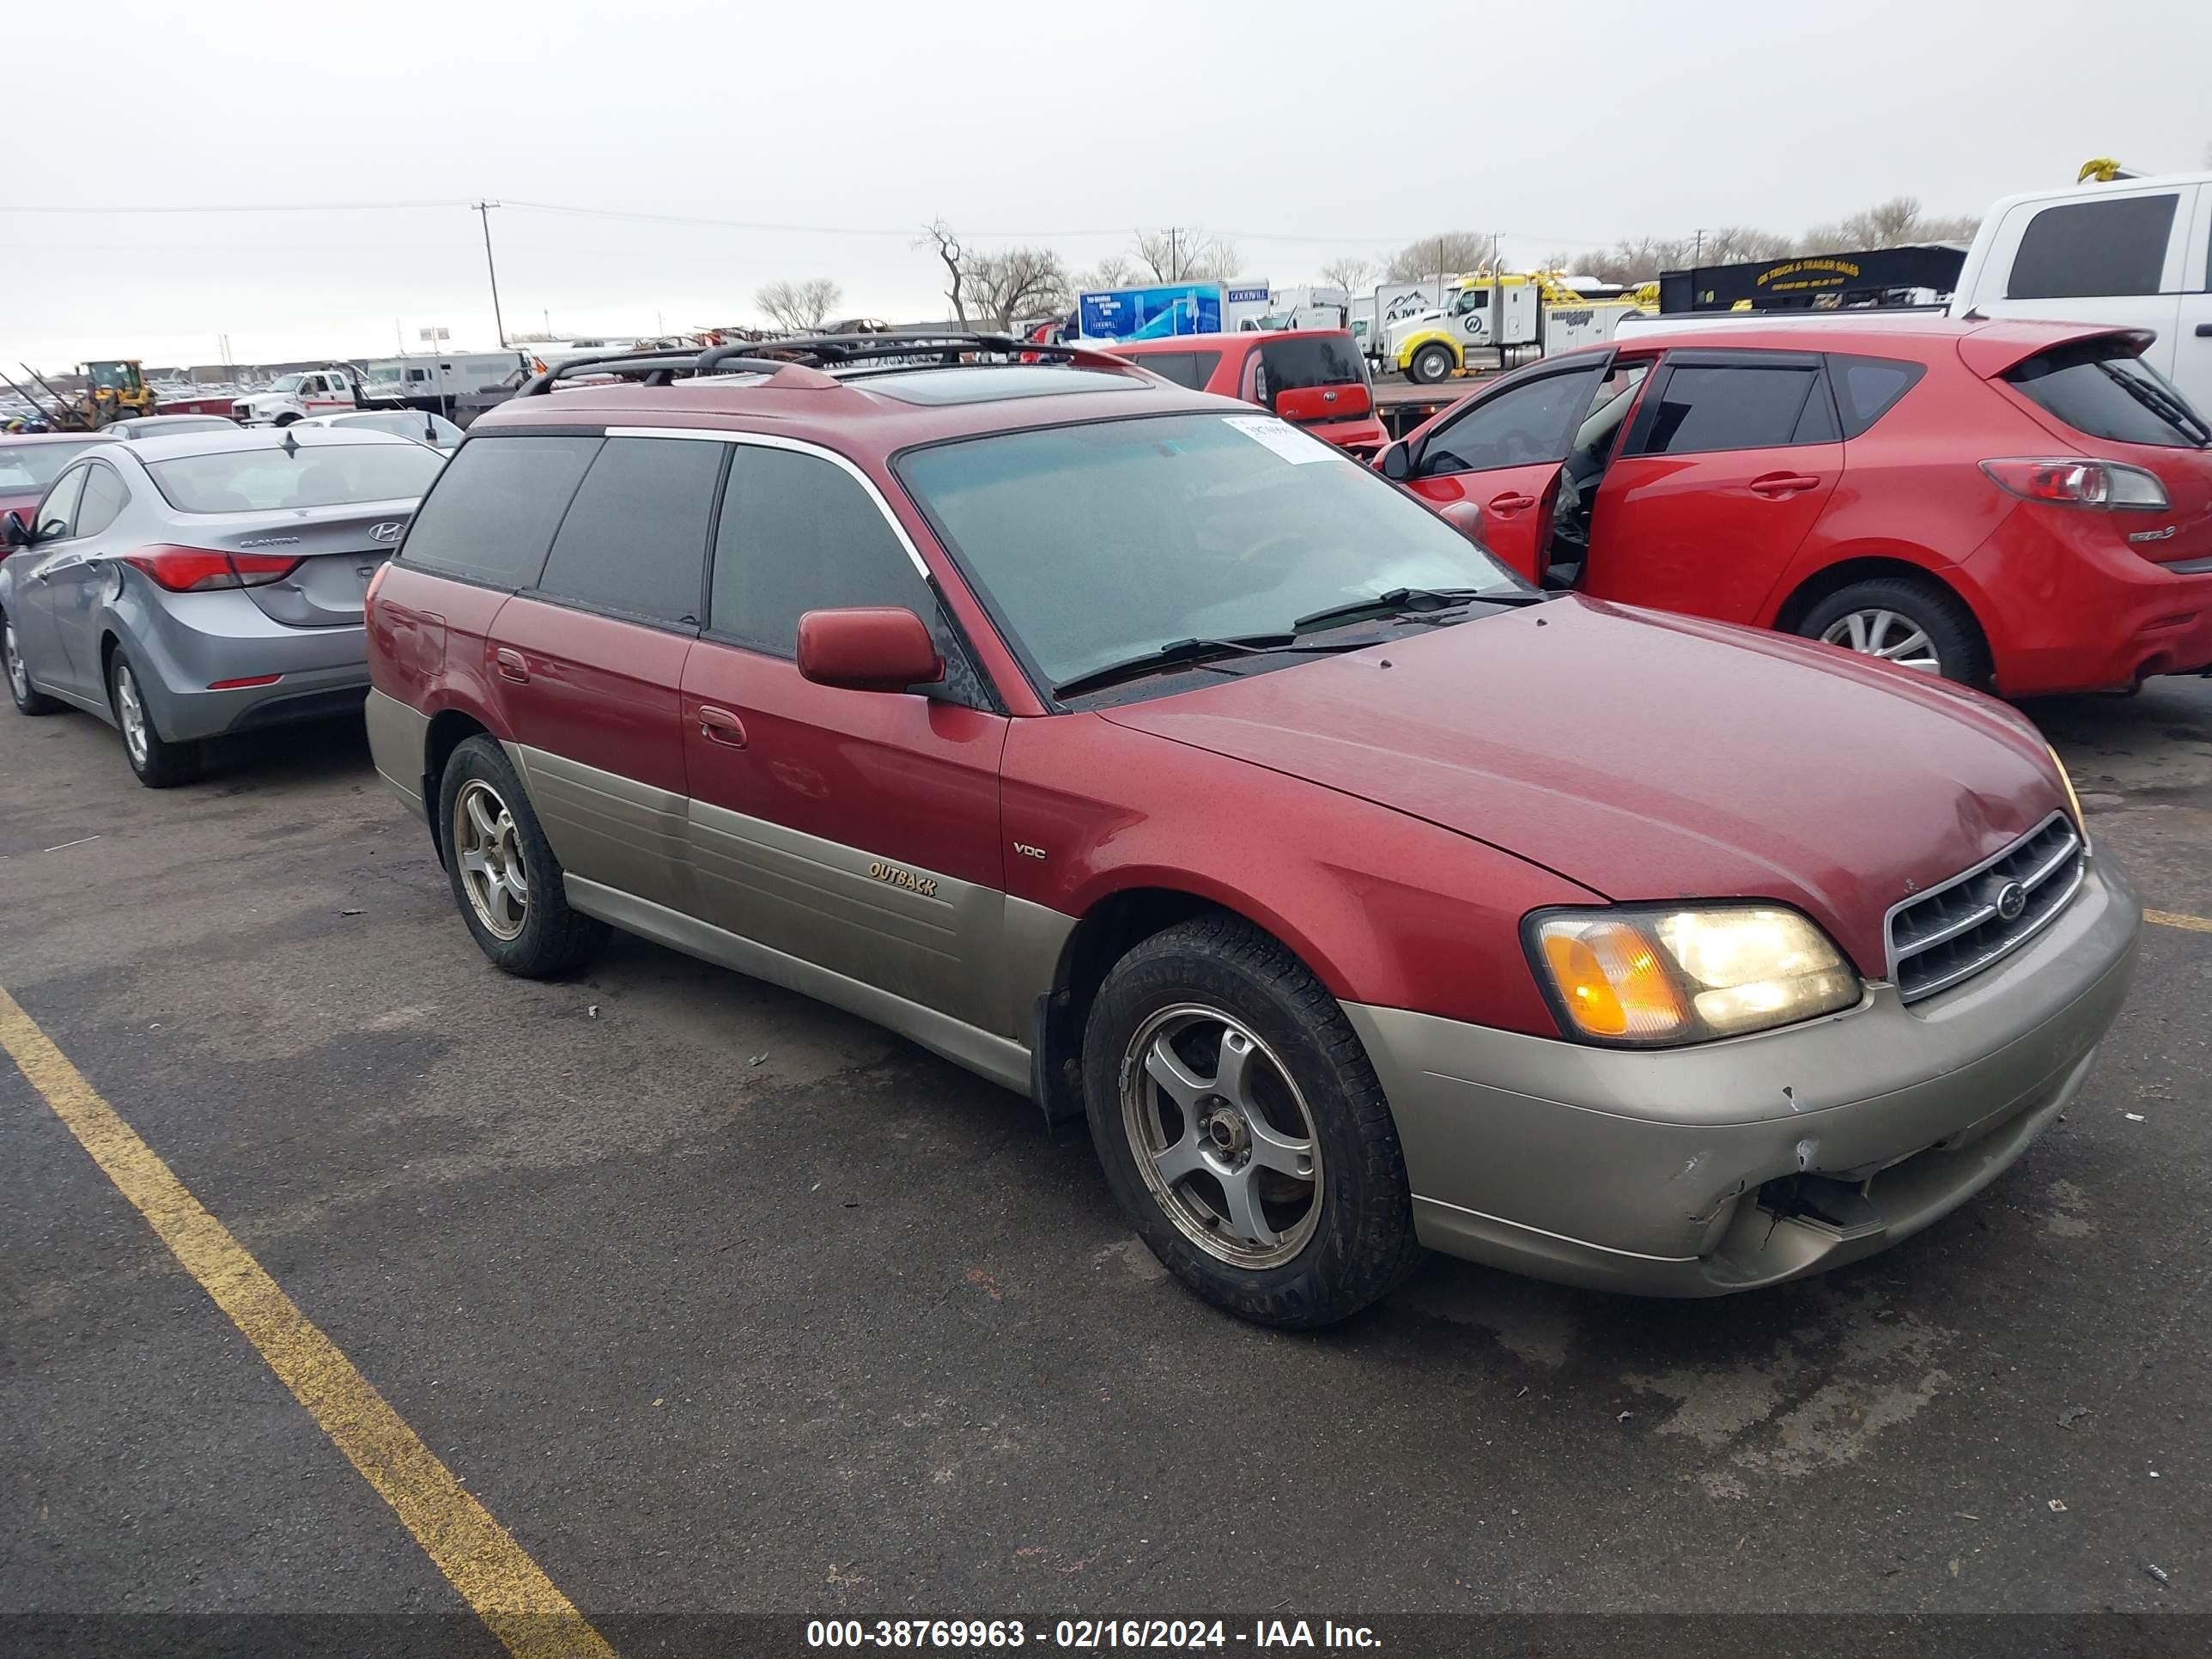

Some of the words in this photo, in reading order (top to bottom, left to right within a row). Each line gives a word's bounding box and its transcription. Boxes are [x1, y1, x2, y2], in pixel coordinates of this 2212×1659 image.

[1835, 260, 1859, 276] SALES
[240, 536, 301, 549] ELANTRA
[1012, 842, 1047, 860] VDC
[869, 861, 938, 897] OUTBACK
